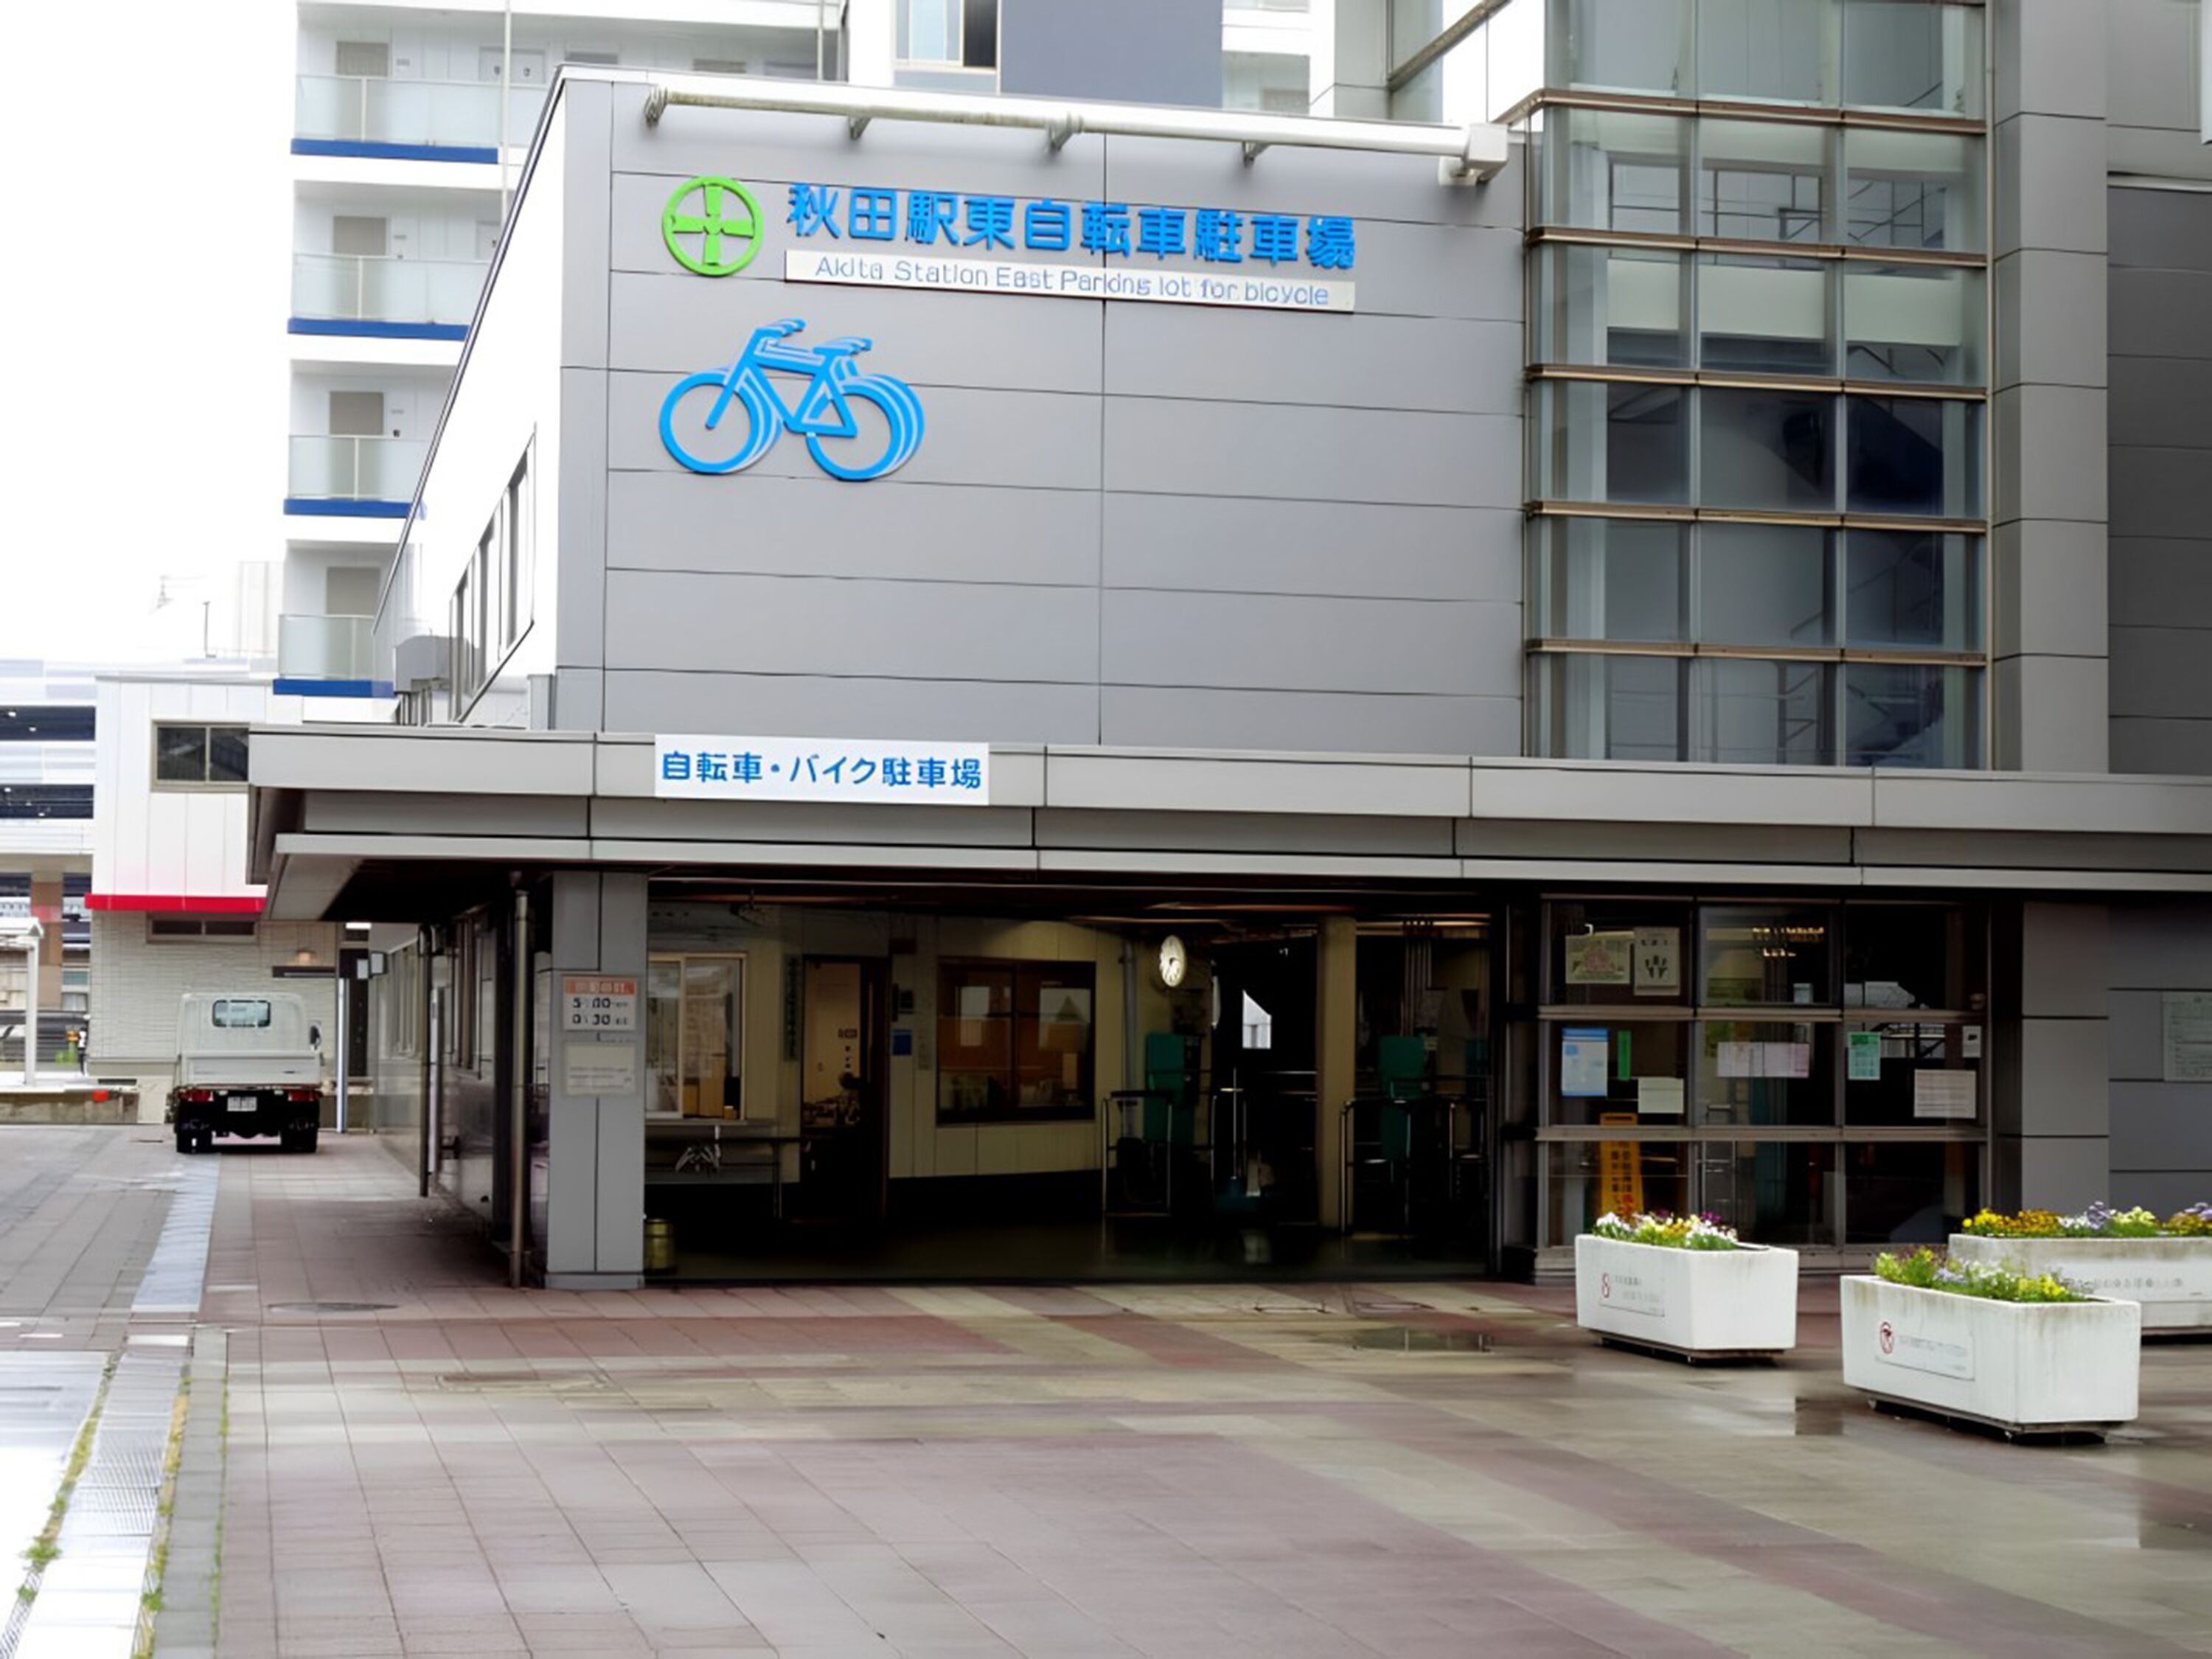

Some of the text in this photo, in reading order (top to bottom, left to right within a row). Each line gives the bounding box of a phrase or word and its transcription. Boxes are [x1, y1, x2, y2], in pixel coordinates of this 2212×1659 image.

[787, 182, 1355, 271] 秋田駅東自転車駐車場
[815, 256, 883, 281] Akita
[894, 260, 989, 286] Station
[995, 266, 1054, 291] East
[1158, 276, 1192, 297] lot
[1200, 279, 1238, 300] for
[1244, 282, 1329, 305] bicycle
[662, 751, 981, 790] 自転車・バイク駐車場
